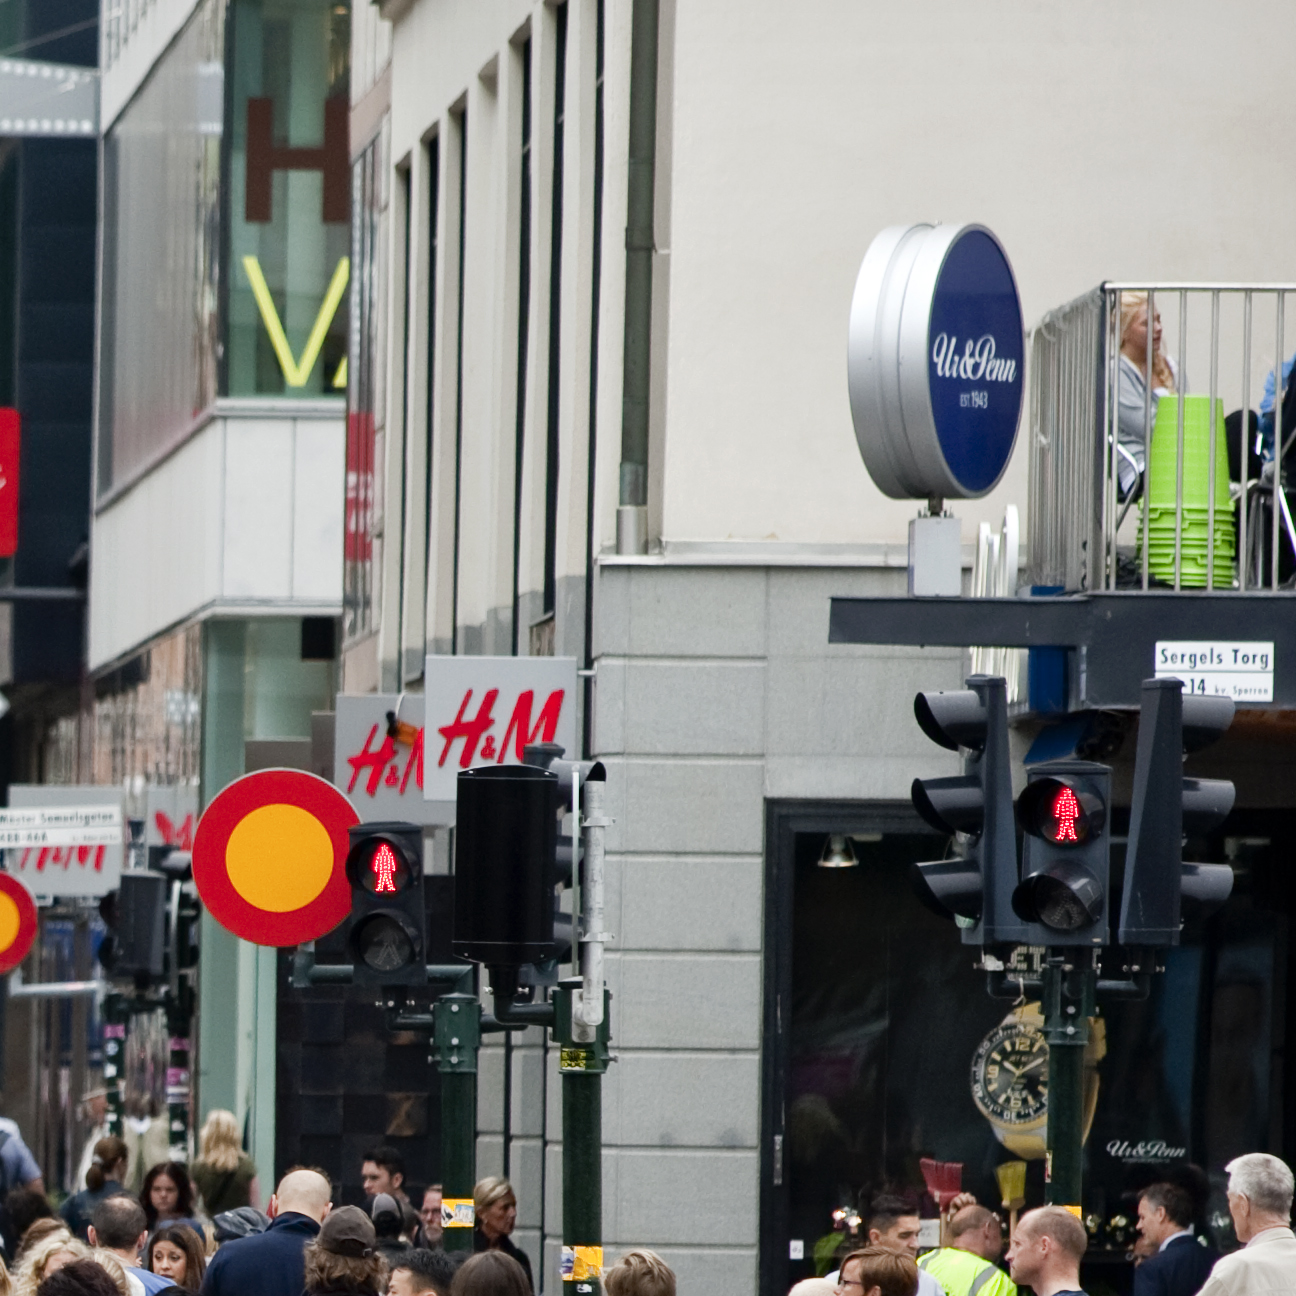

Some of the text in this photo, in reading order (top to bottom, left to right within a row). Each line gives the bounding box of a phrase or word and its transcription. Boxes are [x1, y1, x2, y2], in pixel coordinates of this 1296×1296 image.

[242, 255, 349, 387] V
[933, 332, 1017, 382] Ur&Penn
[971, 391, 988, 409] 1943
[1161, 647, 1269, 671] Sergels Torg
[438, 687, 565, 769] H&M
[1106, 1138, 1186, 1160] Ur&Penn
